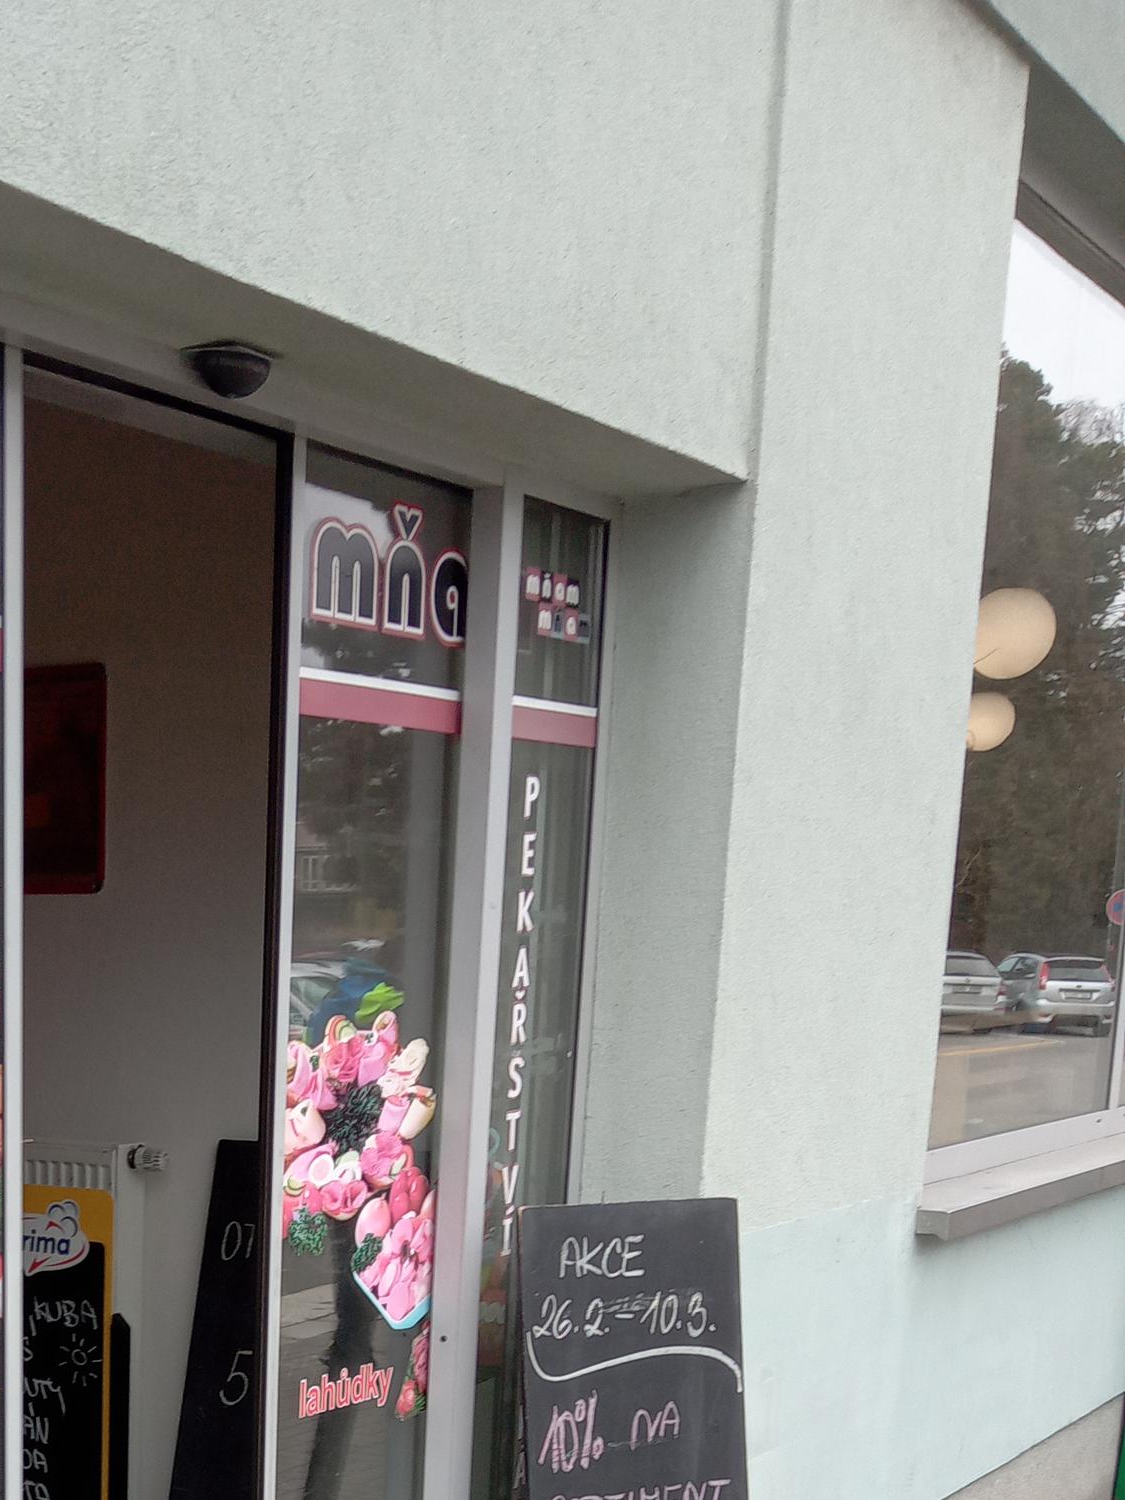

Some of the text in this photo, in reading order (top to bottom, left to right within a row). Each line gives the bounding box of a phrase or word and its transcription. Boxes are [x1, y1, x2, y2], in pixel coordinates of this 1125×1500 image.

[559, 1234, 645, 1279] AKCE
[298, 1362, 394, 1419] lahůdky
[538, 1389, 681, 1474] 10% NA
